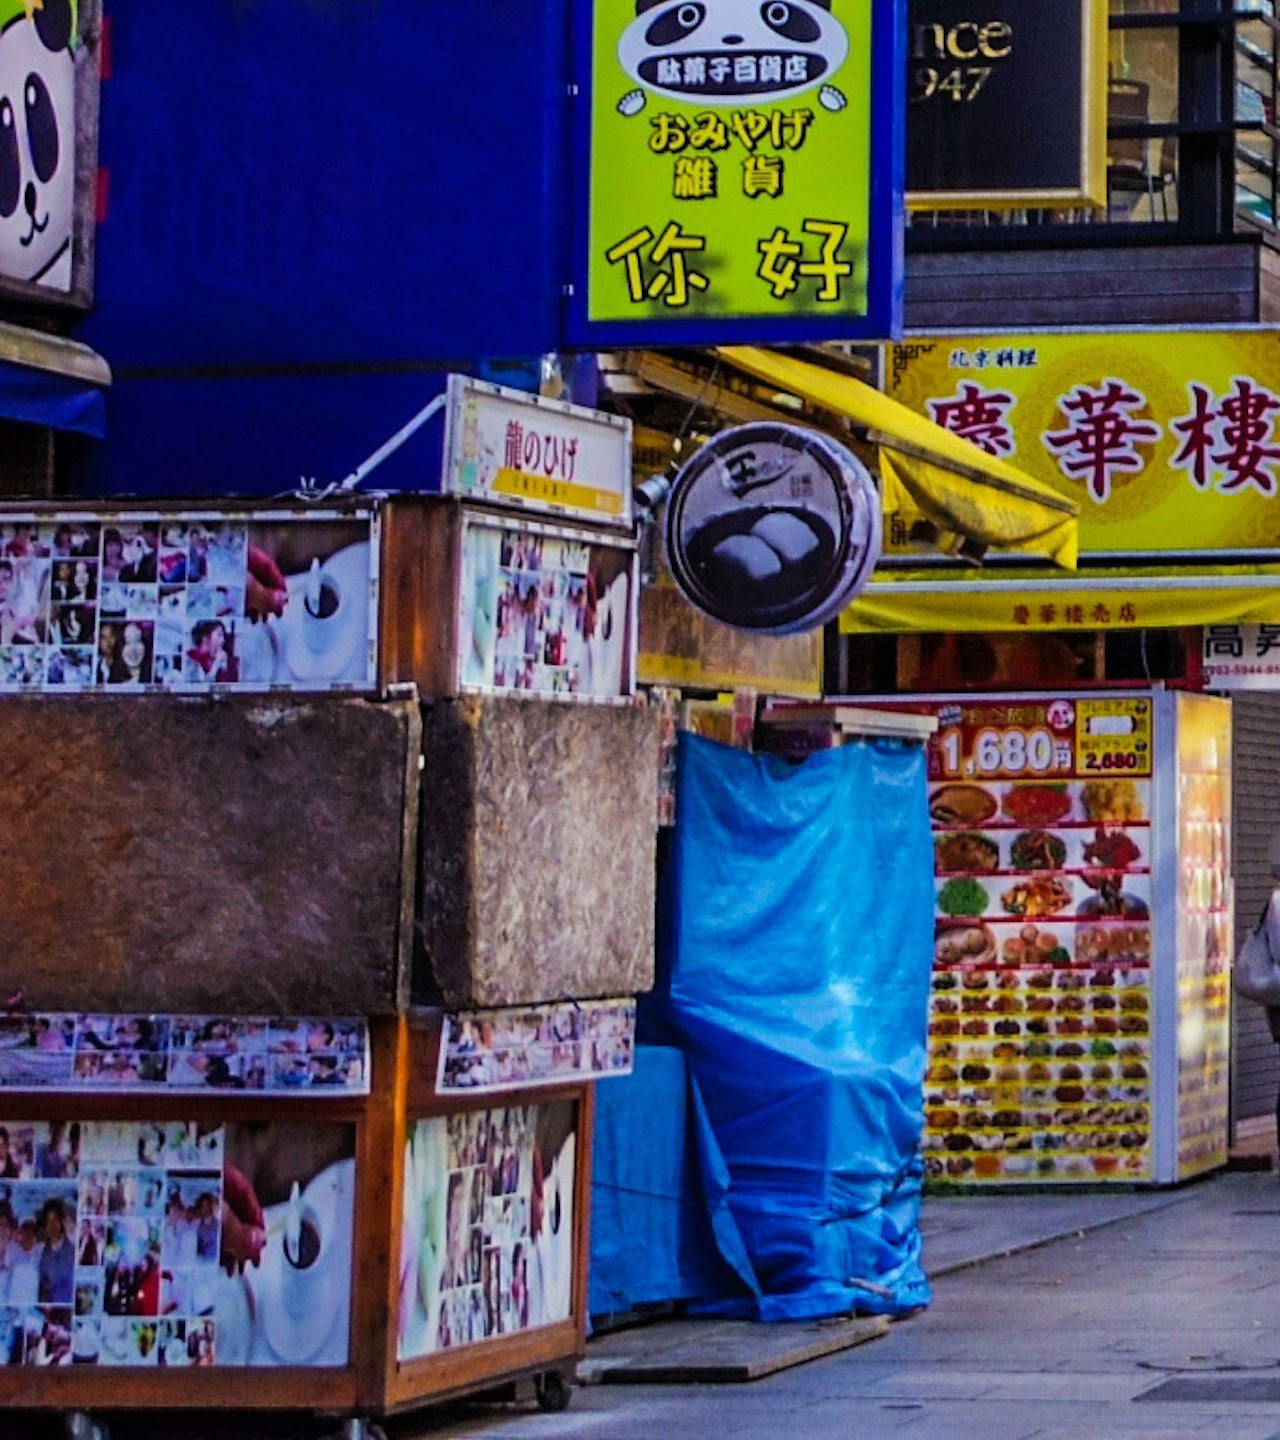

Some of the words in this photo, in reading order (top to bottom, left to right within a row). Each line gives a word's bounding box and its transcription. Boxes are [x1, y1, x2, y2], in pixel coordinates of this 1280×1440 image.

[912, 21, 1013, 58] nce
[656, 55, 808, 86] 駄菓子百貨店
[912, 67, 993, 102] 947
[649, 110, 815, 152] おみやげ
[607, 218, 852, 306] 你好
[950, 347, 1037, 369] 北京料理
[505, 419, 580, 483] 龍のひげ
